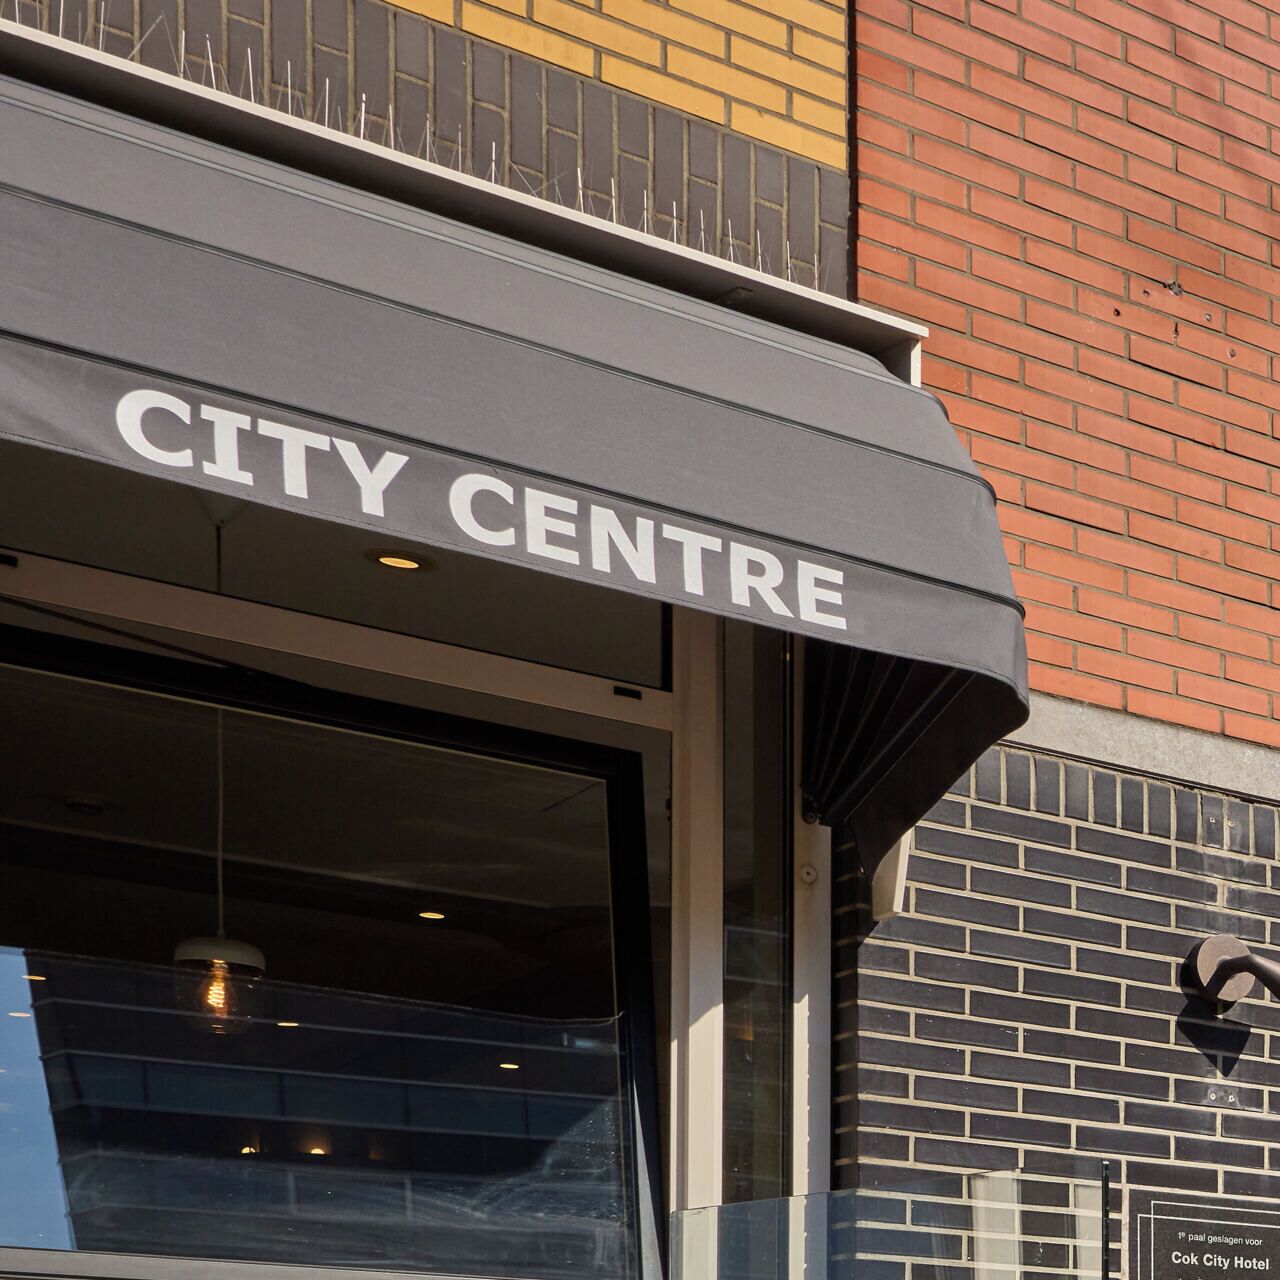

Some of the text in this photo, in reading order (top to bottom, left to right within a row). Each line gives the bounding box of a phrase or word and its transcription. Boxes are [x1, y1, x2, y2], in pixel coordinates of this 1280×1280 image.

[115, 388, 847, 630] CITY CENTRE
[1188, 1233, 1206, 1242] paal
[1207, 1234, 1243, 1246] geslagen
[1245, 1238, 1263, 1246] voor
[1171, 1251, 1270, 1270] Cok City Hotel
